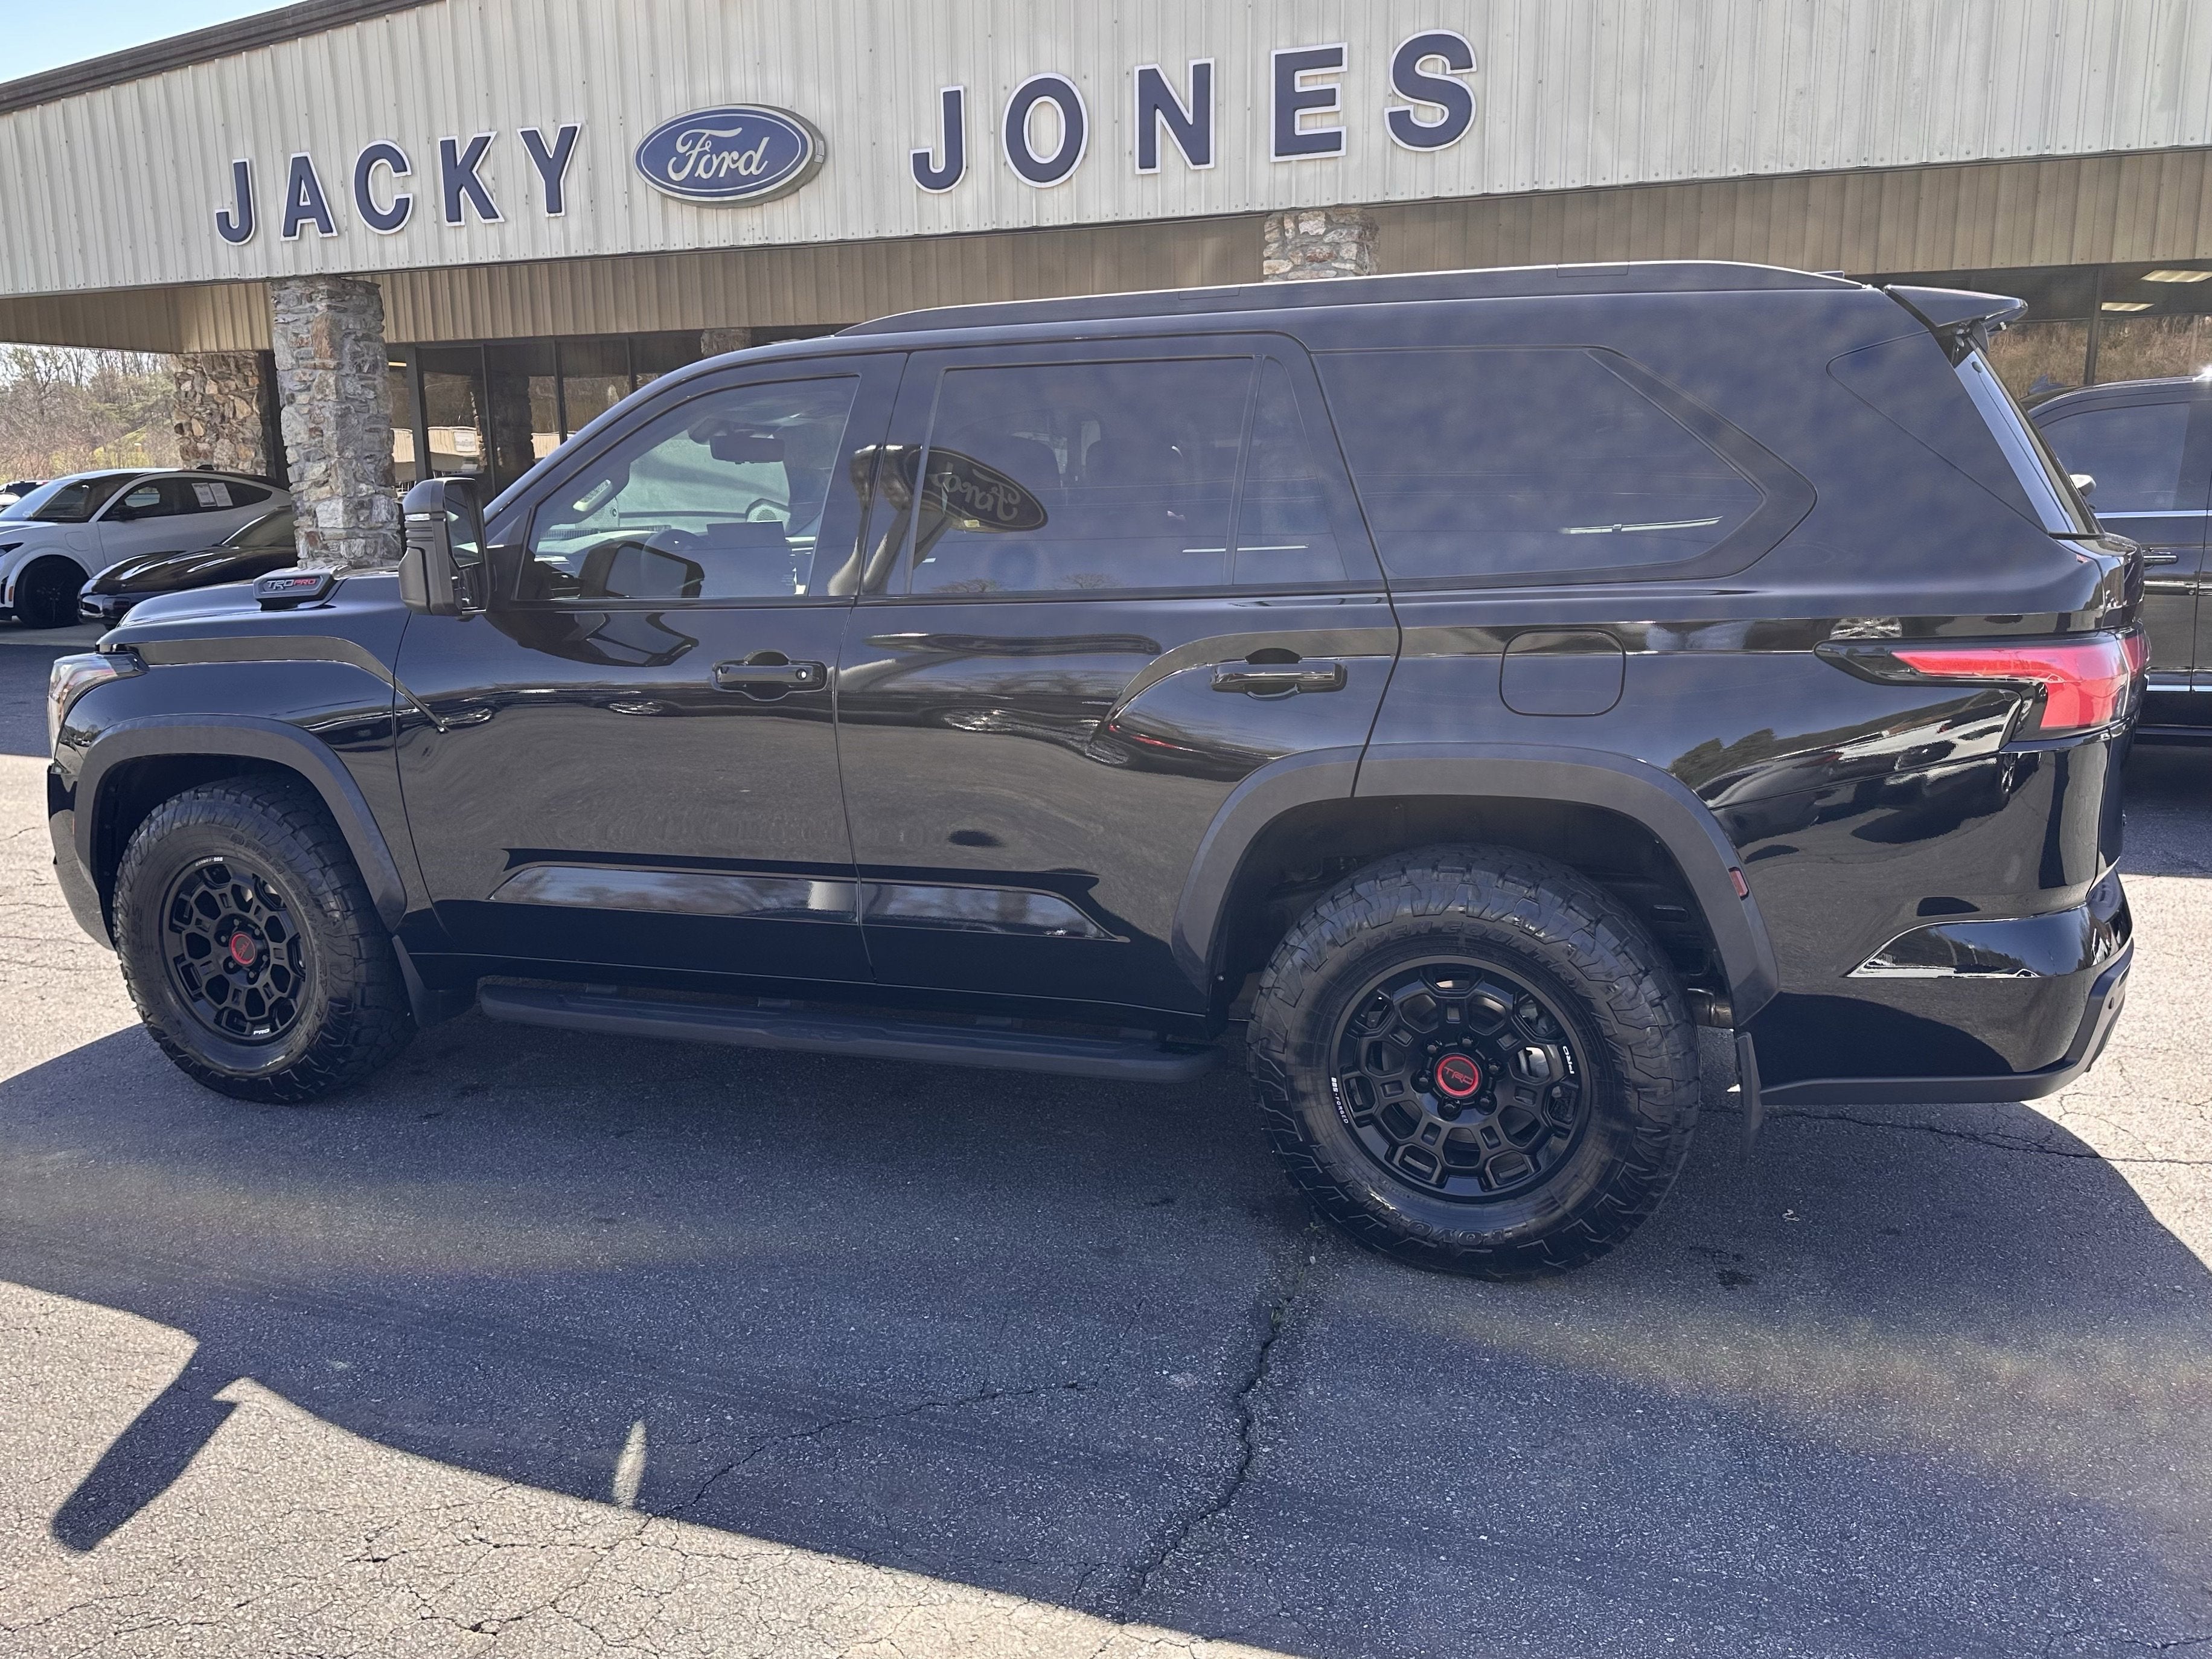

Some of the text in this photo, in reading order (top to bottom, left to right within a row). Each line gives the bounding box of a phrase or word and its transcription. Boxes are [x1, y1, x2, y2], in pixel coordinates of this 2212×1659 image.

[215, 28, 1477, 245] JACKY JONES
[667, 126, 770, 181] Ford
[266, 579, 294, 590] TRD
[1346, 920, 1433, 961] OPEN
[1443, 1066, 1473, 1085] TRD
[1562, 1046, 1574, 1074] PRO
